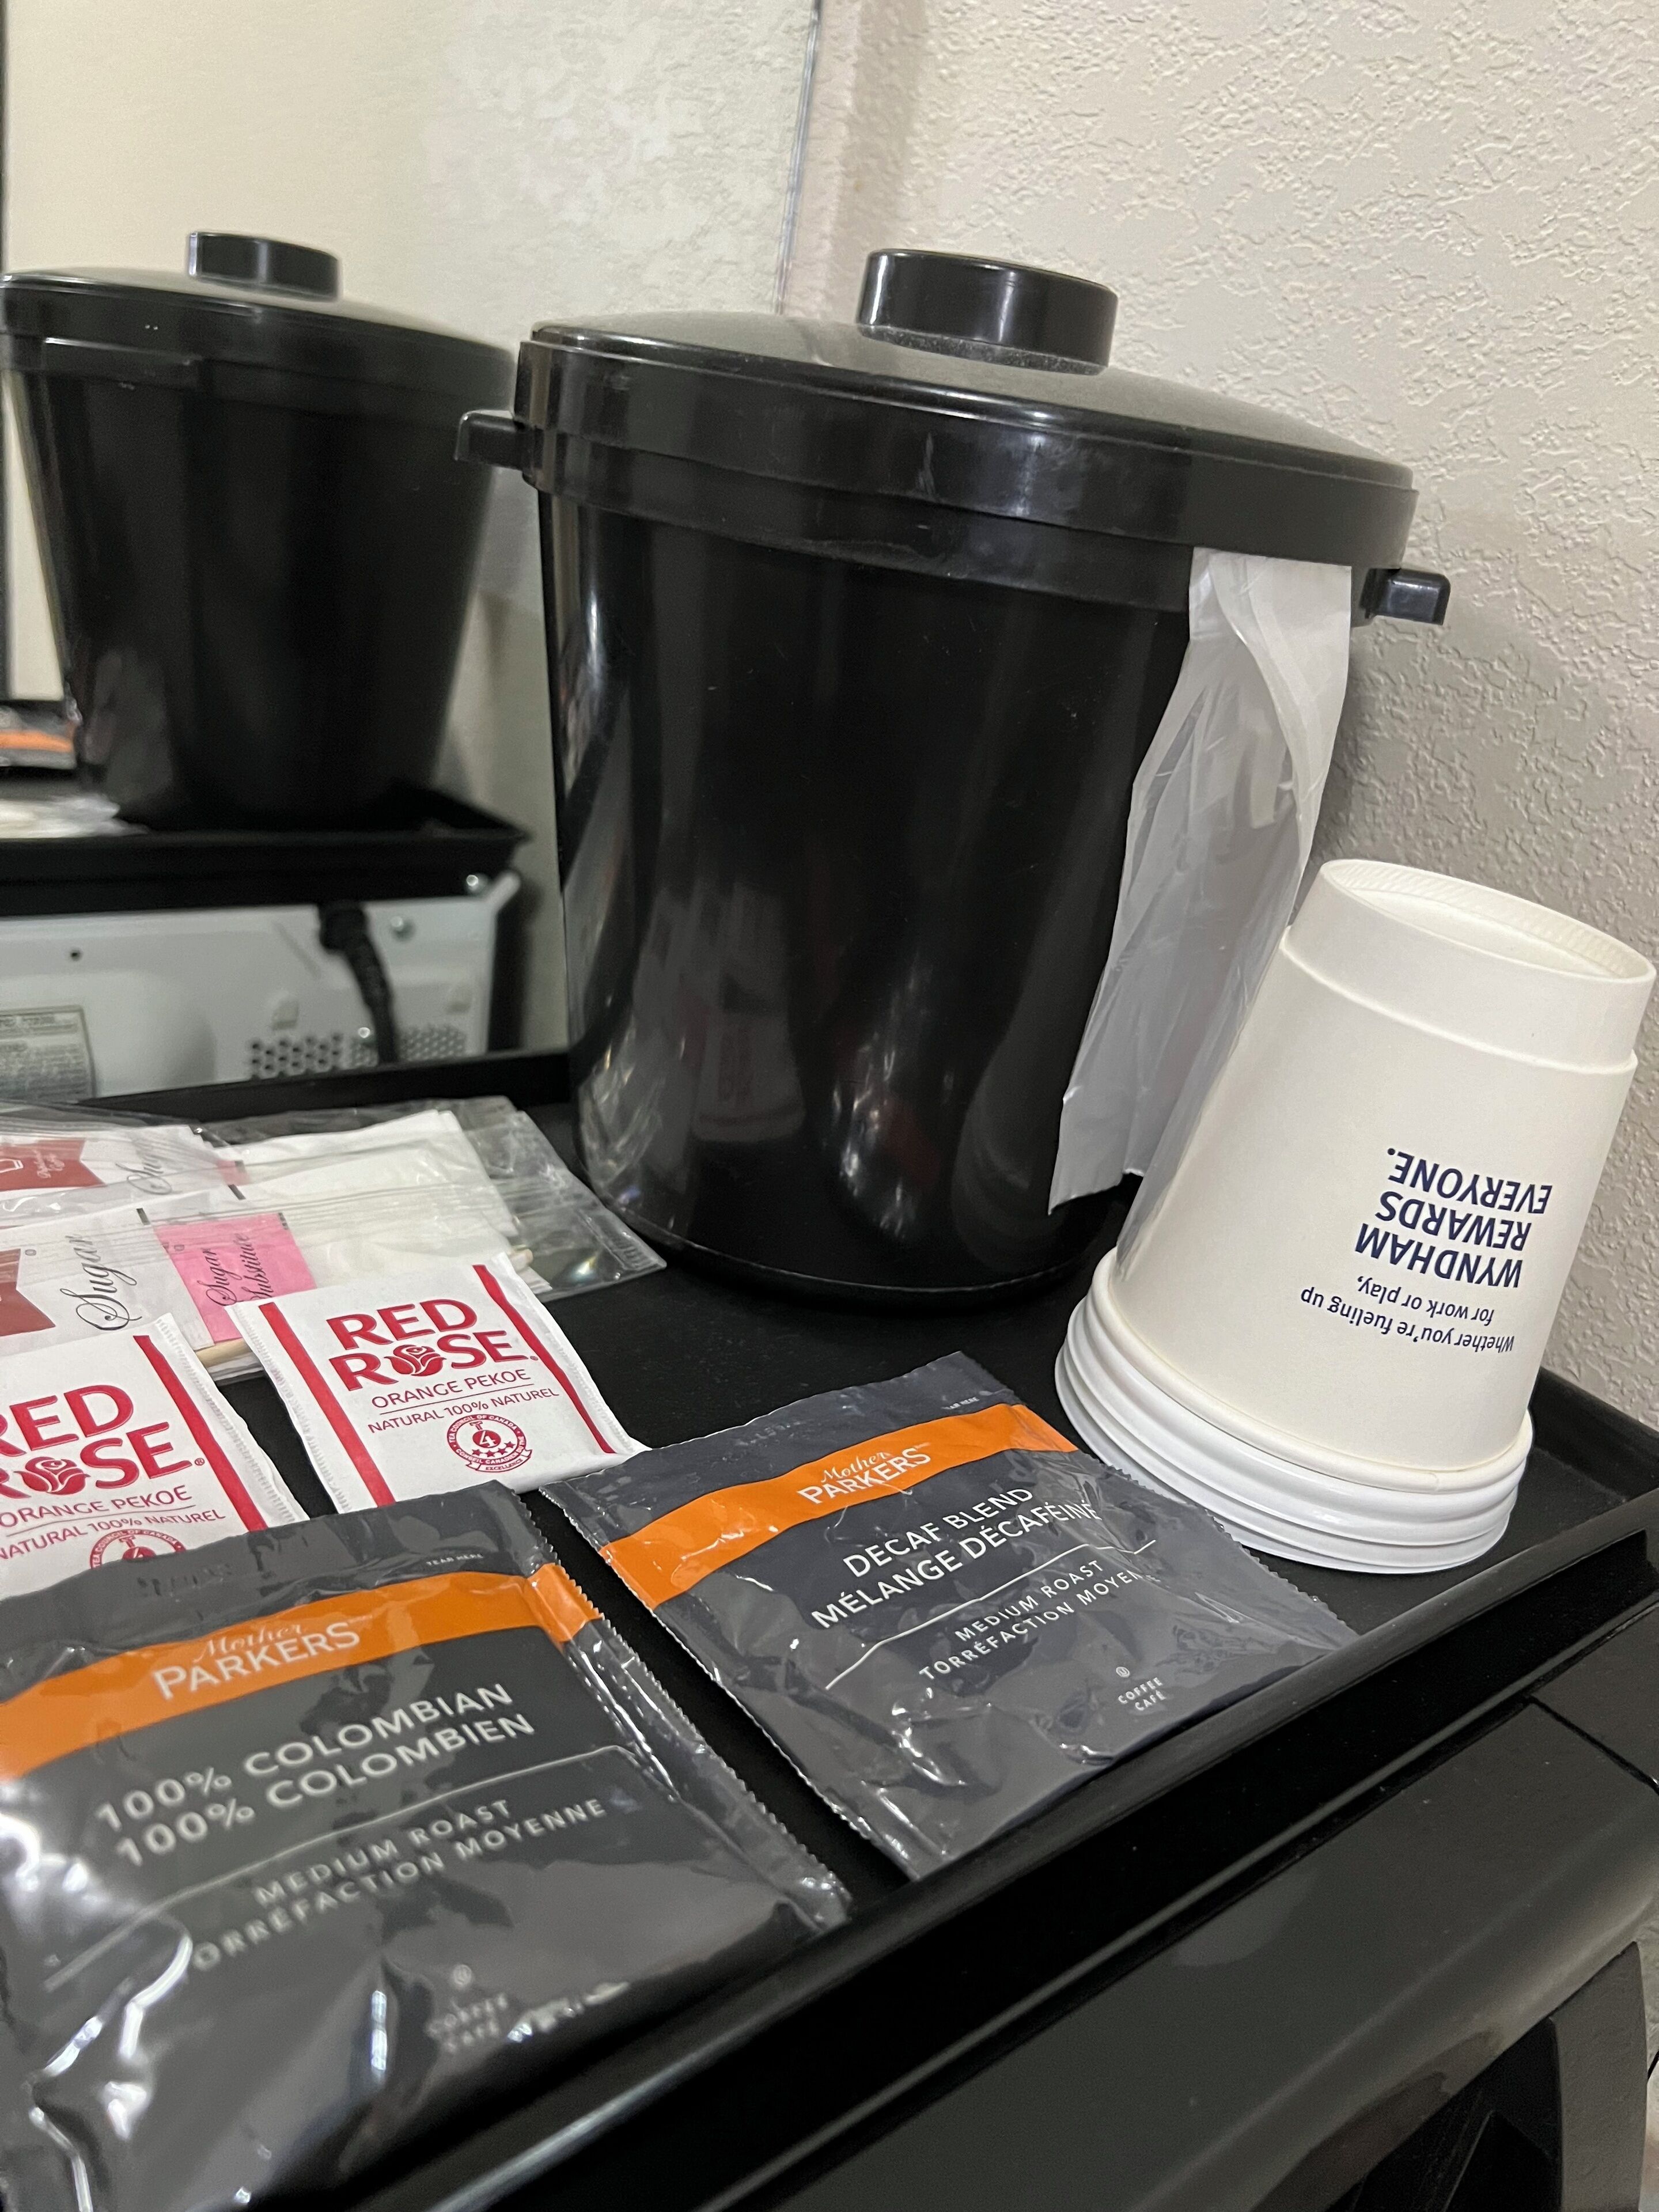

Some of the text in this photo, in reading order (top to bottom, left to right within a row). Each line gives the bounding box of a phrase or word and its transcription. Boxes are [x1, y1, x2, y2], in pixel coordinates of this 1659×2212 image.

[1387, 1147, 1552, 1214] EVERYONE.
[1376, 1191, 1532, 1251] REWARDS
[60, 1234, 142, 1331] Sugar
[197, 1248, 244, 1306] Sugar
[233, 1233, 274, 1300] Substitute
[1355, 1223, 1523, 1288] WYNDHAM
[326, 1299, 477, 1350] RED
[1301, 1287, 1514, 1353] Whether you're fueling up
[1357, 1276, 1494, 1326] for work or play,
[368, 1388, 559, 1433] NATURAL 100% NATUREL
[372, 1369, 531, 1408] ORANGE PEKOE
[488, 1415, 517, 1430] CANADA
[456, 1448, 483, 1464] CONSEIL
[797, 1448, 931, 1504] PARKERS
[821, 1452, 892, 1483] Mother
[0, 1485, 192, 1527] ORANGE PEKOE
[88, 1518, 142, 1532] 100%
[145, 1509, 225, 1526] NATUREL
[843, 1488, 1033, 1578] DECAF BLEND
[95, 1532, 127, 1552] COUNCIL
[143, 1530, 179, 1545] CANADA
[811, 1550, 963, 1628] MÉLANGE
[955, 1560, 1103, 1641] MEDIUM ROAST
[152, 1622, 361, 1700] PARKERS
[193, 1624, 302, 1663] Mother
[919, 1601, 1074, 1680] TORRÉFACTION
[1118, 1677, 1163, 1705] COFFEE
[96, 1684, 513, 1831] 100% COLOMBIAN
[116, 1714, 534, 1866] 100% COLOMBIEN
[254, 1800, 510, 1907] MEDIUM ROAST
[192, 1799, 605, 1971] ORRÉFACTION MOYENNE
